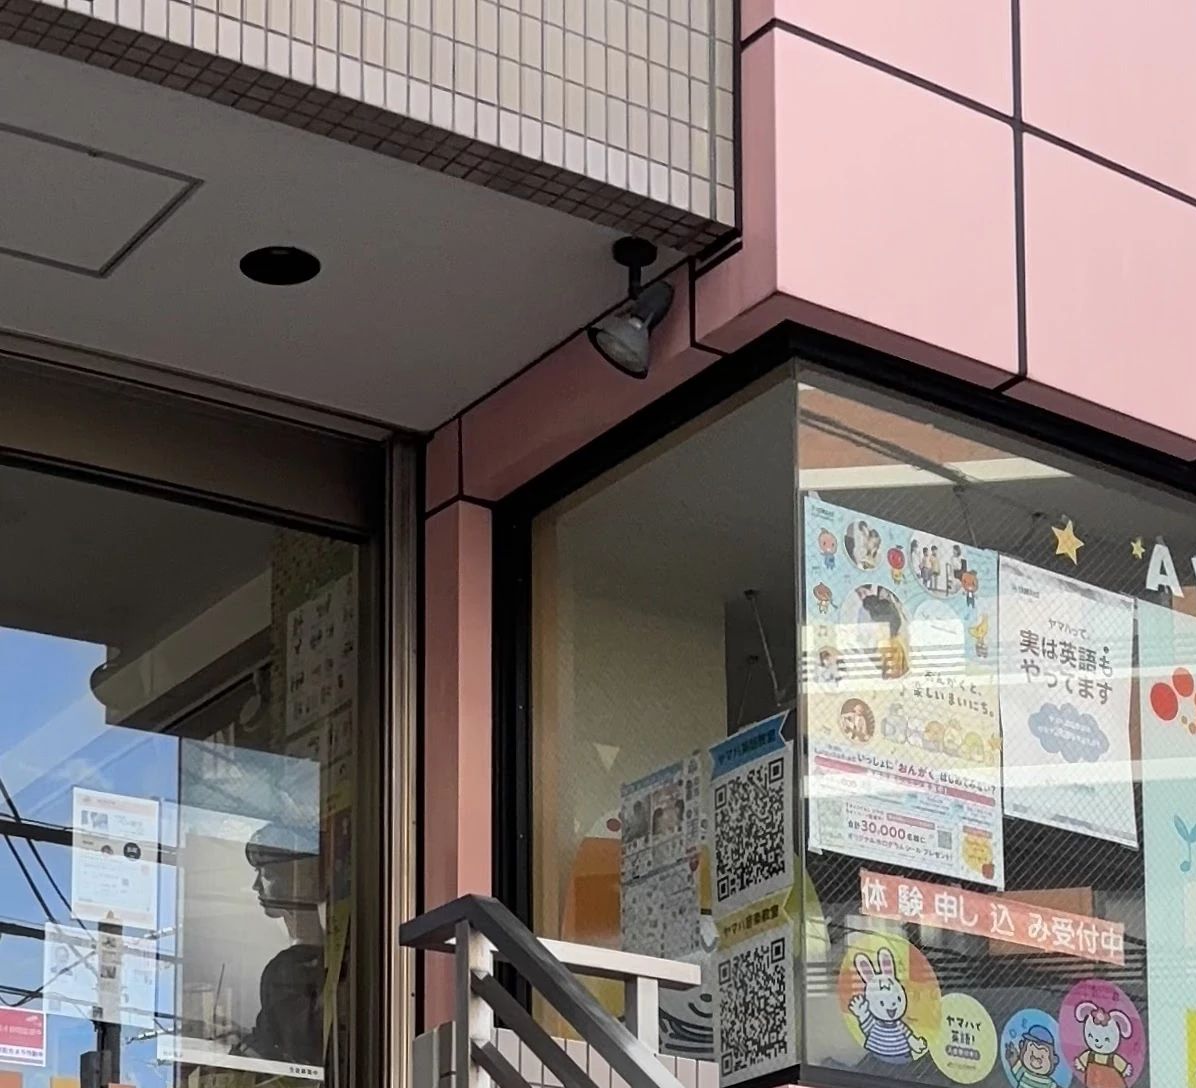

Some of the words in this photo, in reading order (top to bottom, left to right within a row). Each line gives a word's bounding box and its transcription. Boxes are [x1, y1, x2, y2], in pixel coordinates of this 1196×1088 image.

[1146, 544, 1183, 597] A
[1019, 629, 1113, 678] 実は英語も
[1020, 658, 1113, 705] やってます
[861, 878, 1124, 957] 体験申し込み受付中
